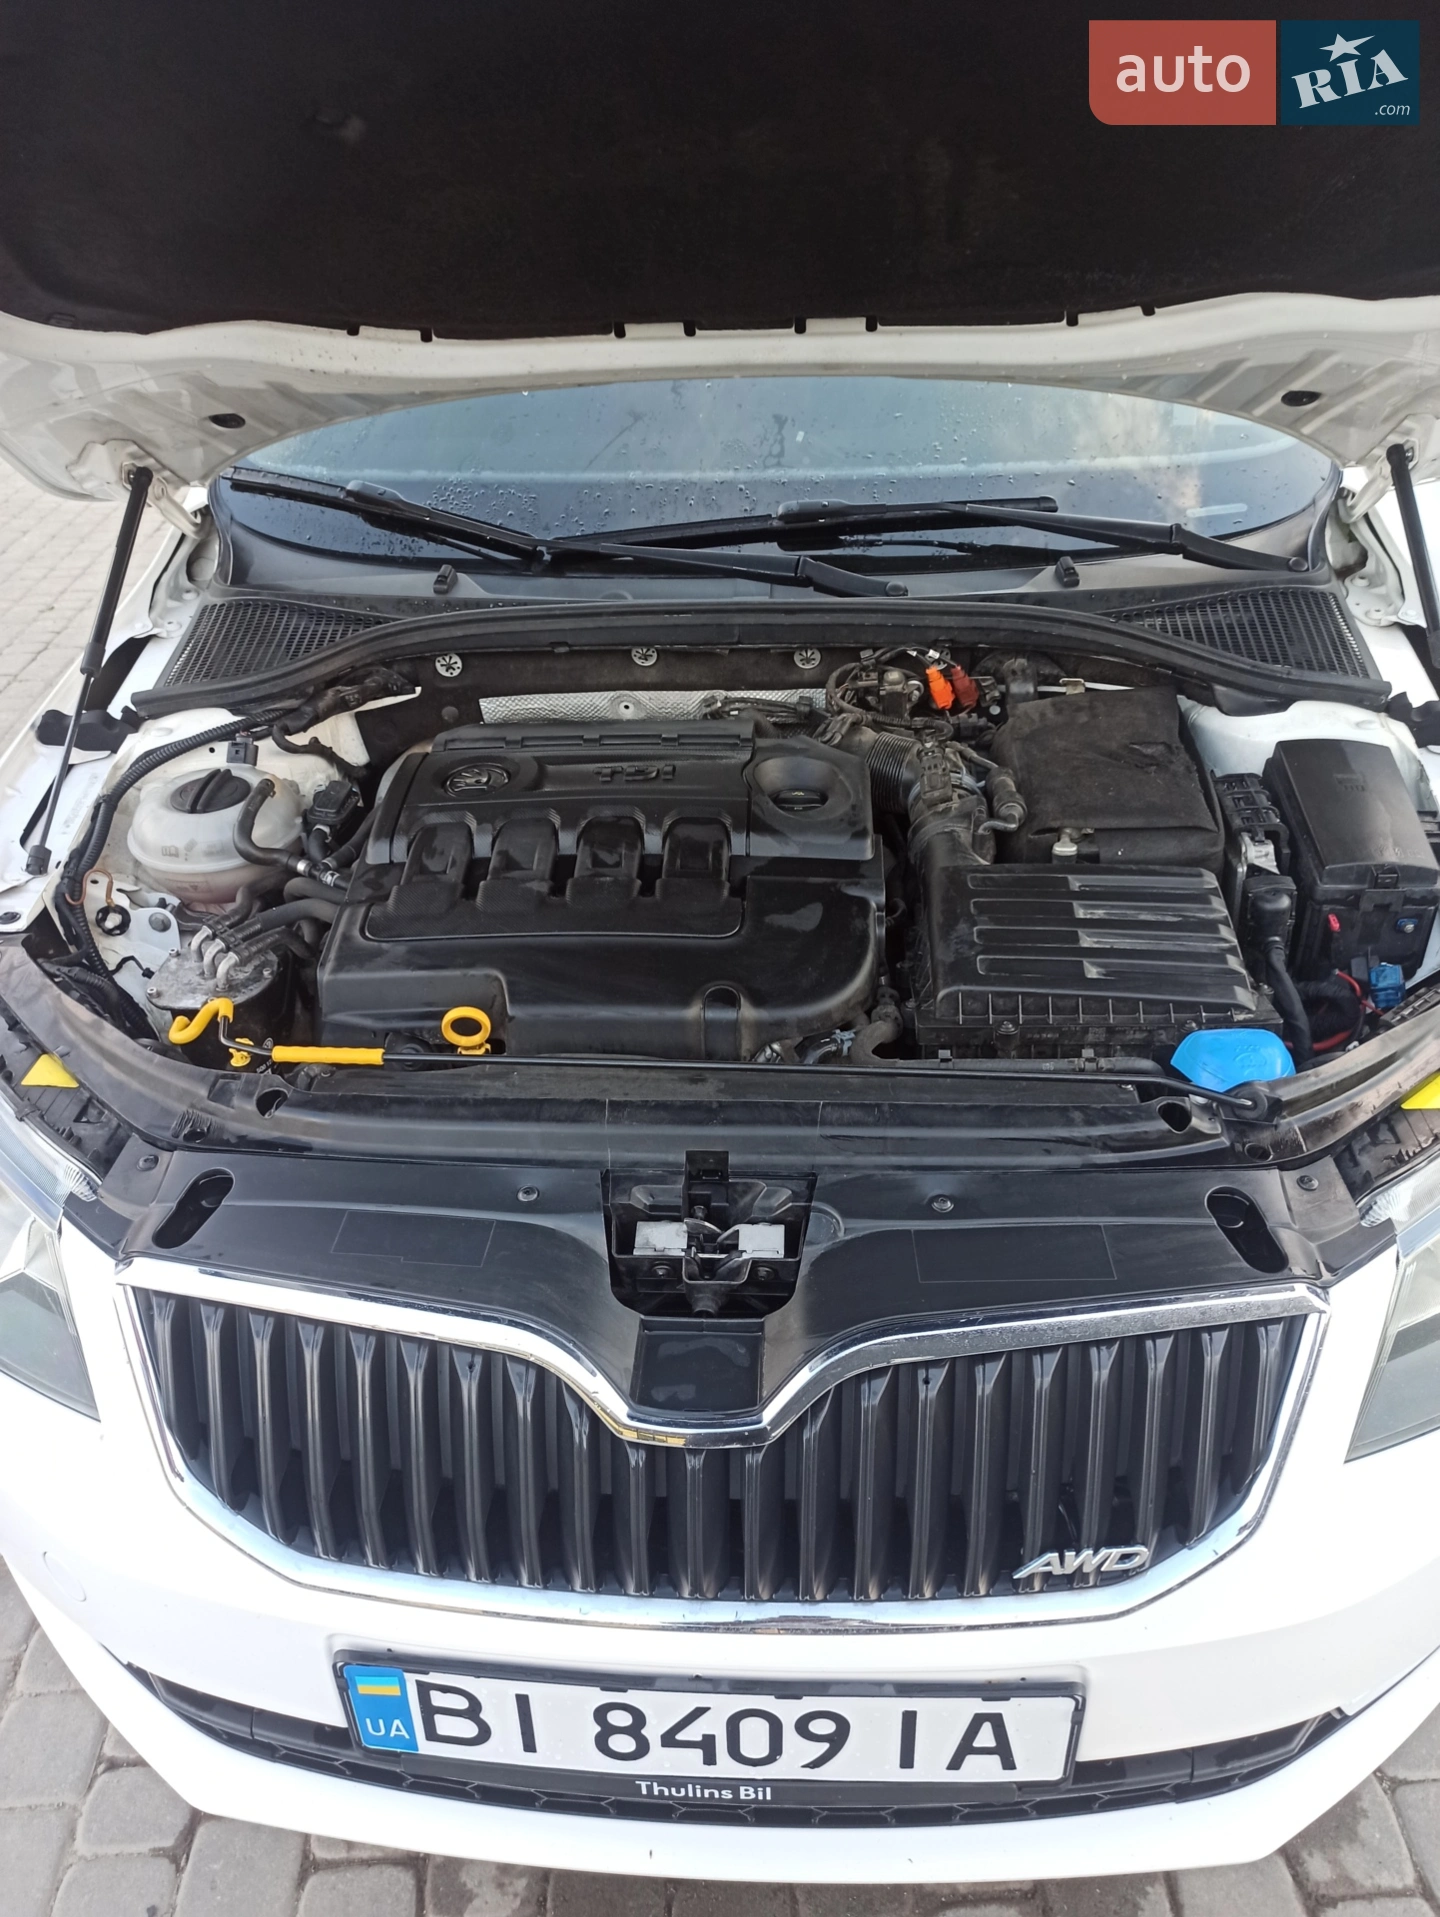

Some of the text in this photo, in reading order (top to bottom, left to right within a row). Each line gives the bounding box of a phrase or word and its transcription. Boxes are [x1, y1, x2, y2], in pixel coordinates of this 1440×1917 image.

[592, 765, 676, 781] TDI
[1012, 1545, 1149, 1579] AWD
[365, 1717, 410, 1739] UA
[415, 1679, 1017, 1770] BI 8409 IA
[635, 1780, 772, 1800] Thulins Bil
